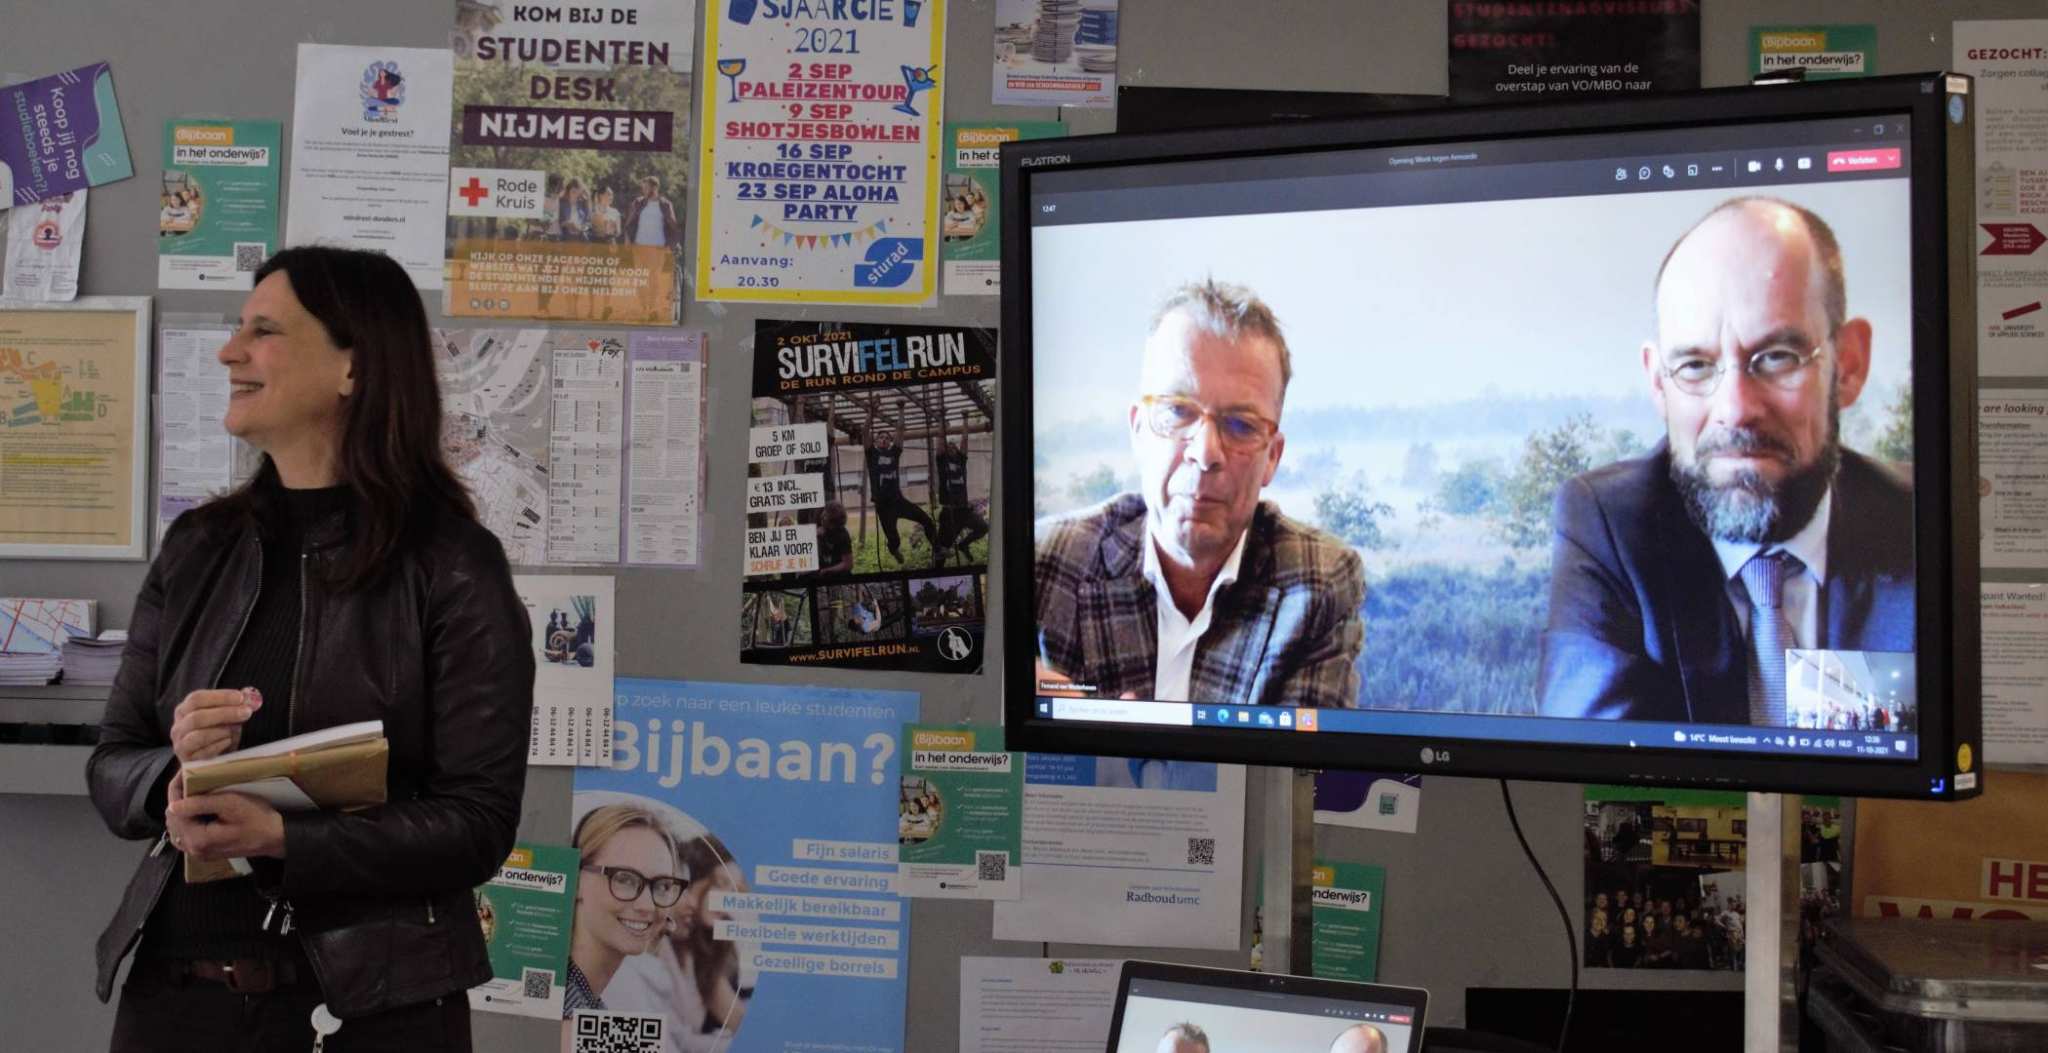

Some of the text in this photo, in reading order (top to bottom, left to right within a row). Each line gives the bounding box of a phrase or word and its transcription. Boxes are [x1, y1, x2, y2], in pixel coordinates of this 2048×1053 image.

[514, 6, 638, 25] KOM BIJ DE
[795, 27, 861, 54] 2021
[477, 36, 669, 65] STUDENTEN
[1967, 48, 2048, 60] GEZOCHT:
[1763, 54, 1861, 66] in het onderwijs?
[788, 63, 853, 80] 2 SEP
[1508, 63, 1639, 78] Deel je ervaring van de
[530, 75, 616, 101] DESK
[739, 82, 907, 100] PALEIZENTOUR
[1496, 79, 1652, 93] overstap van VO/MBO naar
[788, 104, 853, 120] 9 SEP
[50, 87, 68, 130] Koop
[64, 149, 80, 180] nog
[480, 112, 656, 143] NIJMEGEN
[726, 122, 920, 142] SHOTJESBOWLEN
[33, 104, 59, 173] steeds je
[177, 148, 266, 160] in het onderwijs?
[777, 145, 853, 160] 16 SEP
[960, 151, 970, 160] in
[972, 151, 990, 160] het
[1021, 155, 1070, 167] FLATRON
[727, 163, 907, 180] KROEGENTOCHT
[496, 178, 537, 193] Rode
[737, 183, 899, 201] 23 SEP ALOHA
[496, 195, 536, 210] Kruis
[784, 204, 858, 222] PARTY
[720, 254, 794, 270] Aanvang:
[866, 242, 909, 287] sturad
[737, 276, 780, 288] 20.30
[777, 331, 852, 346] 2 OKT 2021
[777, 332, 966, 380] SURVIFELRUN
[780, 364, 982, 390] DE RUN ROND DE CAMPUS
[1983, 403, 2045, 415] are looking
[772, 429, 795, 442] 5 KM
[756, 441, 821, 458] GROEP OF SOLO
[763, 481, 774, 493] 13
[778, 480, 800, 492] INCL.
[750, 491, 819, 508] GRATIS SHIRT
[748, 531, 766, 544] BEN
[785, 529, 798, 541] ER
[750, 542, 813, 558] KLAAR VOOR?
[633, 692, 896, 719] zoek naar een leuke studenten
[612, 717, 896, 789] Bijbaan?
[915, 752, 1008, 767] in het onderwijs?
[1435, 751, 1450, 763] LG
[806, 843, 889, 860] Fijn salaris
[505, 868, 564, 887] onderwijs?
[768, 869, 889, 890] Goede ervaring
[1127, 891, 1200, 905] Radboudumc
[1312, 889, 1368, 904] nderwijs?
[723, 895, 886, 916] Makkelijk bereikbaar
[726, 924, 887, 946] Flexibele werktijden
[753, 954, 885, 974] Gezellige borrels
